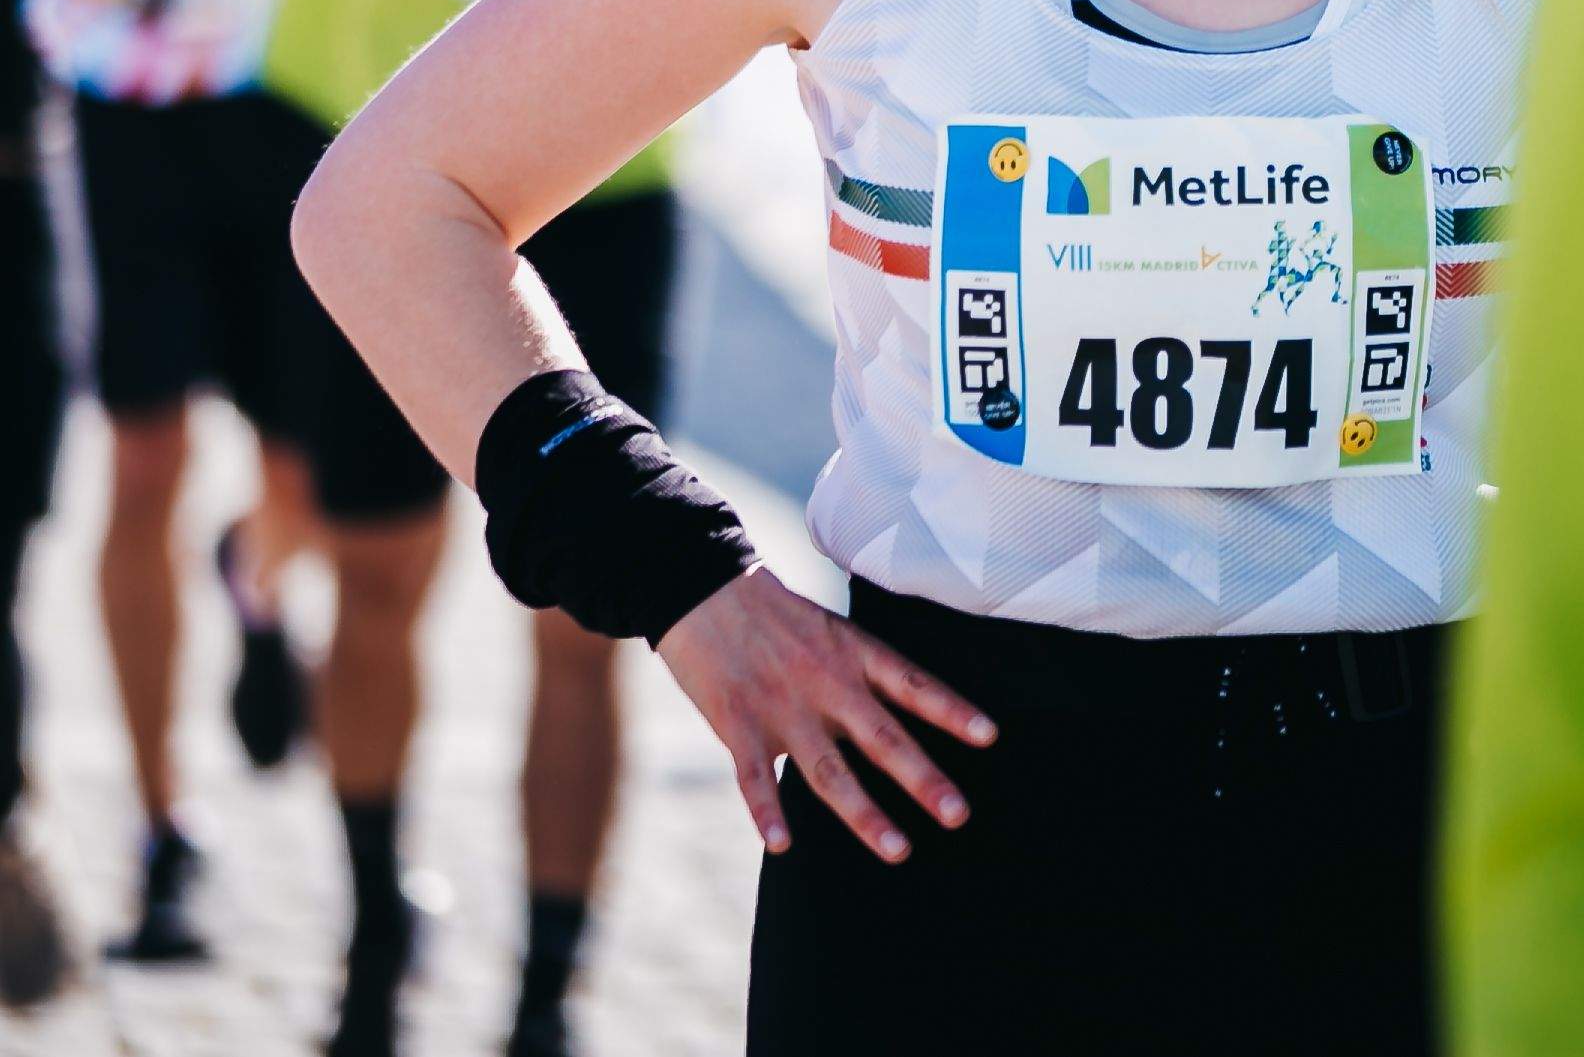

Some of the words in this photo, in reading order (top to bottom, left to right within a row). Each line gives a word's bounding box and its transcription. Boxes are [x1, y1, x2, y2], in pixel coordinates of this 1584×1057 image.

[1132, 164, 1330, 206] MetLife
[1046, 244, 1092, 272] VIII
[1097, 260, 1135, 271] 15KM
[1140, 260, 1199, 271] MADRID
[1058, 336, 1319, 450] 4874
